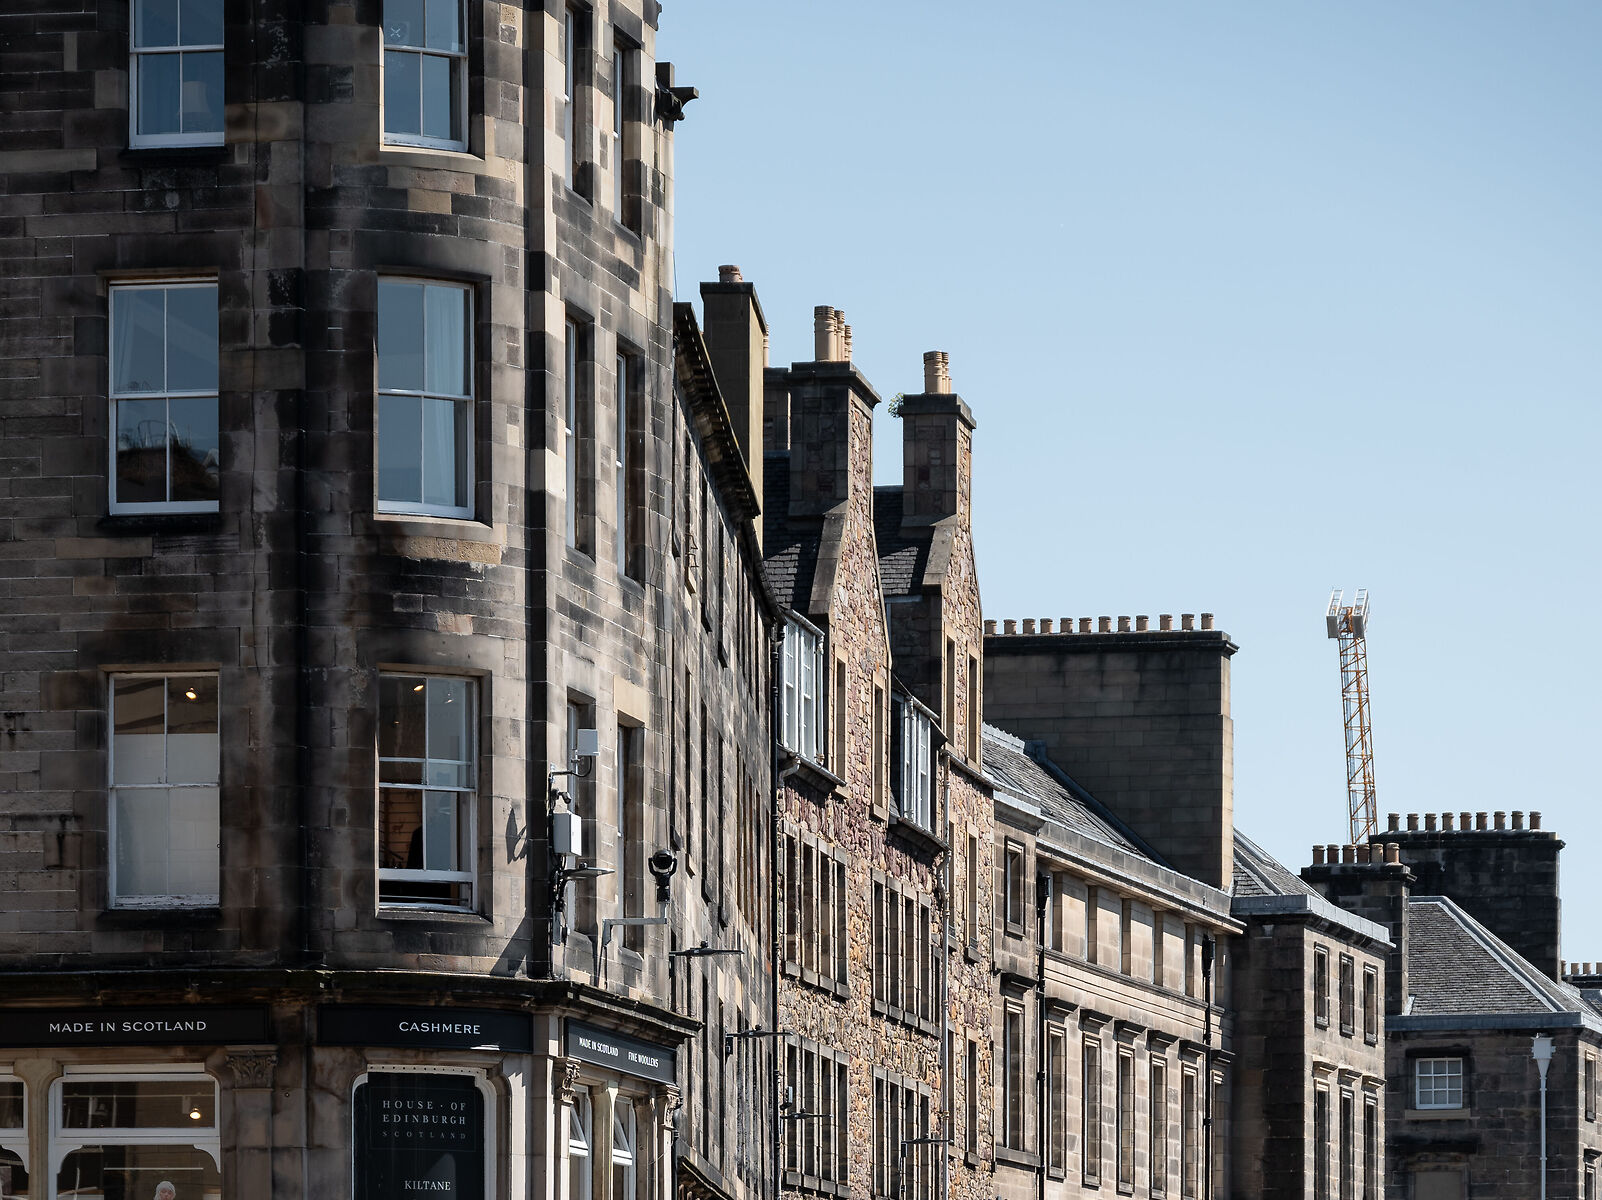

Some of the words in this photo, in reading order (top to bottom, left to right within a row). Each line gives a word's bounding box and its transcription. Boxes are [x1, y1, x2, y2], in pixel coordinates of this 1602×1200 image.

[49, 1022, 94, 1033] MADE
[100, 1022, 116, 1032] IN
[122, 1021, 207, 1032] SCOTLAND
[398, 1021, 481, 1035] CASHMERE
[578, 1036, 592, 1050] MADE
[592, 1040, 597, 1051] IN
[597, 1042, 619, 1057] SCOTLAND
[628, 1051, 638, 1063] FINE
[638, 1054, 659, 1068] WOOLLENS
[383, 1100, 434, 1110] HOUSE
[450, 1102, 467, 1111] OF
[383, 1114, 466, 1125] EDINBURGH
[382, 1131, 466, 1140] SCOTLAND
[404, 1180, 451, 1191] KILTANE
